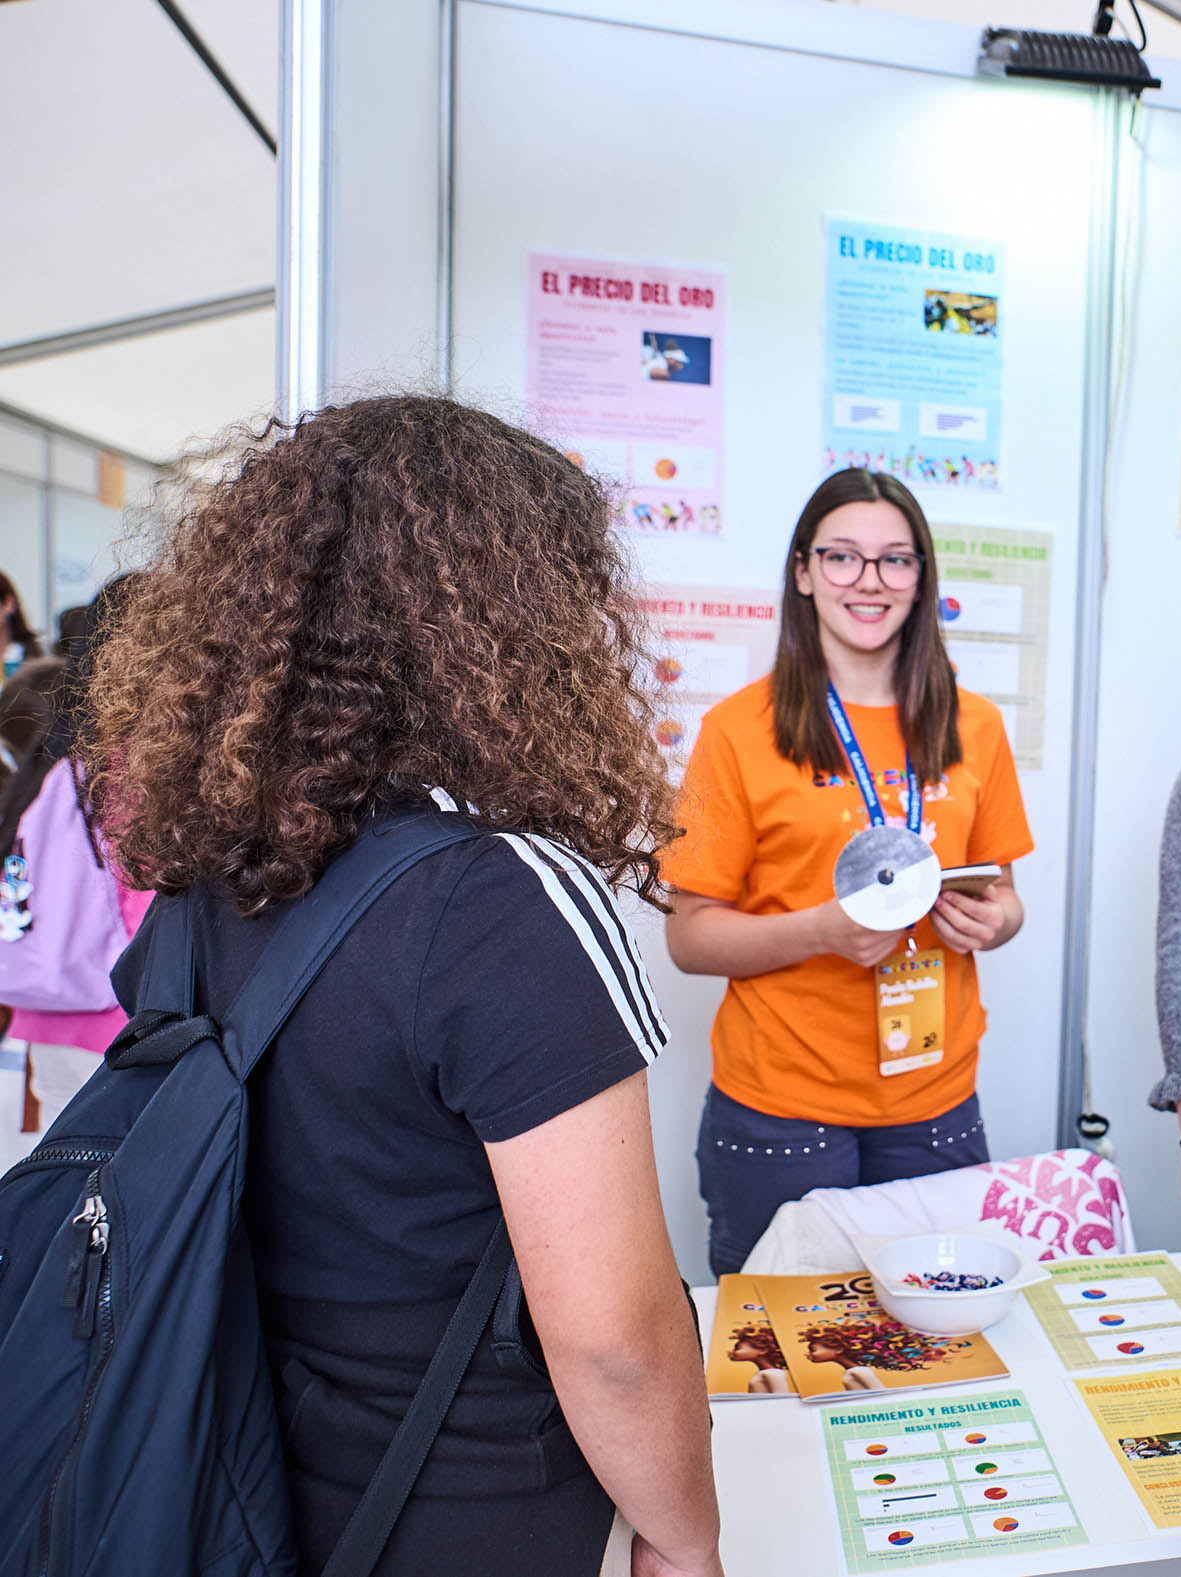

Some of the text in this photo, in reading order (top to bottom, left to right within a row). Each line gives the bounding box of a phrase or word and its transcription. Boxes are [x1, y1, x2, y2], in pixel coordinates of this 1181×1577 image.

[840, 235, 856, 258] EL
[864, 239, 922, 264] PRECIO
[928, 247, 955, 270] DEL
[963, 252, 995, 273] ORO
[542, 271, 714, 309] EL PRECIO DEL ORO
[1084, 1378, 1170, 1394] RENDIMIENTO
[1173, 1376, 1181, 1386] Y
[830, 1398, 1022, 1426] RENDIMIENTO Y RESILIENCIA
[904, 1421, 962, 1433] RESULTADOS
